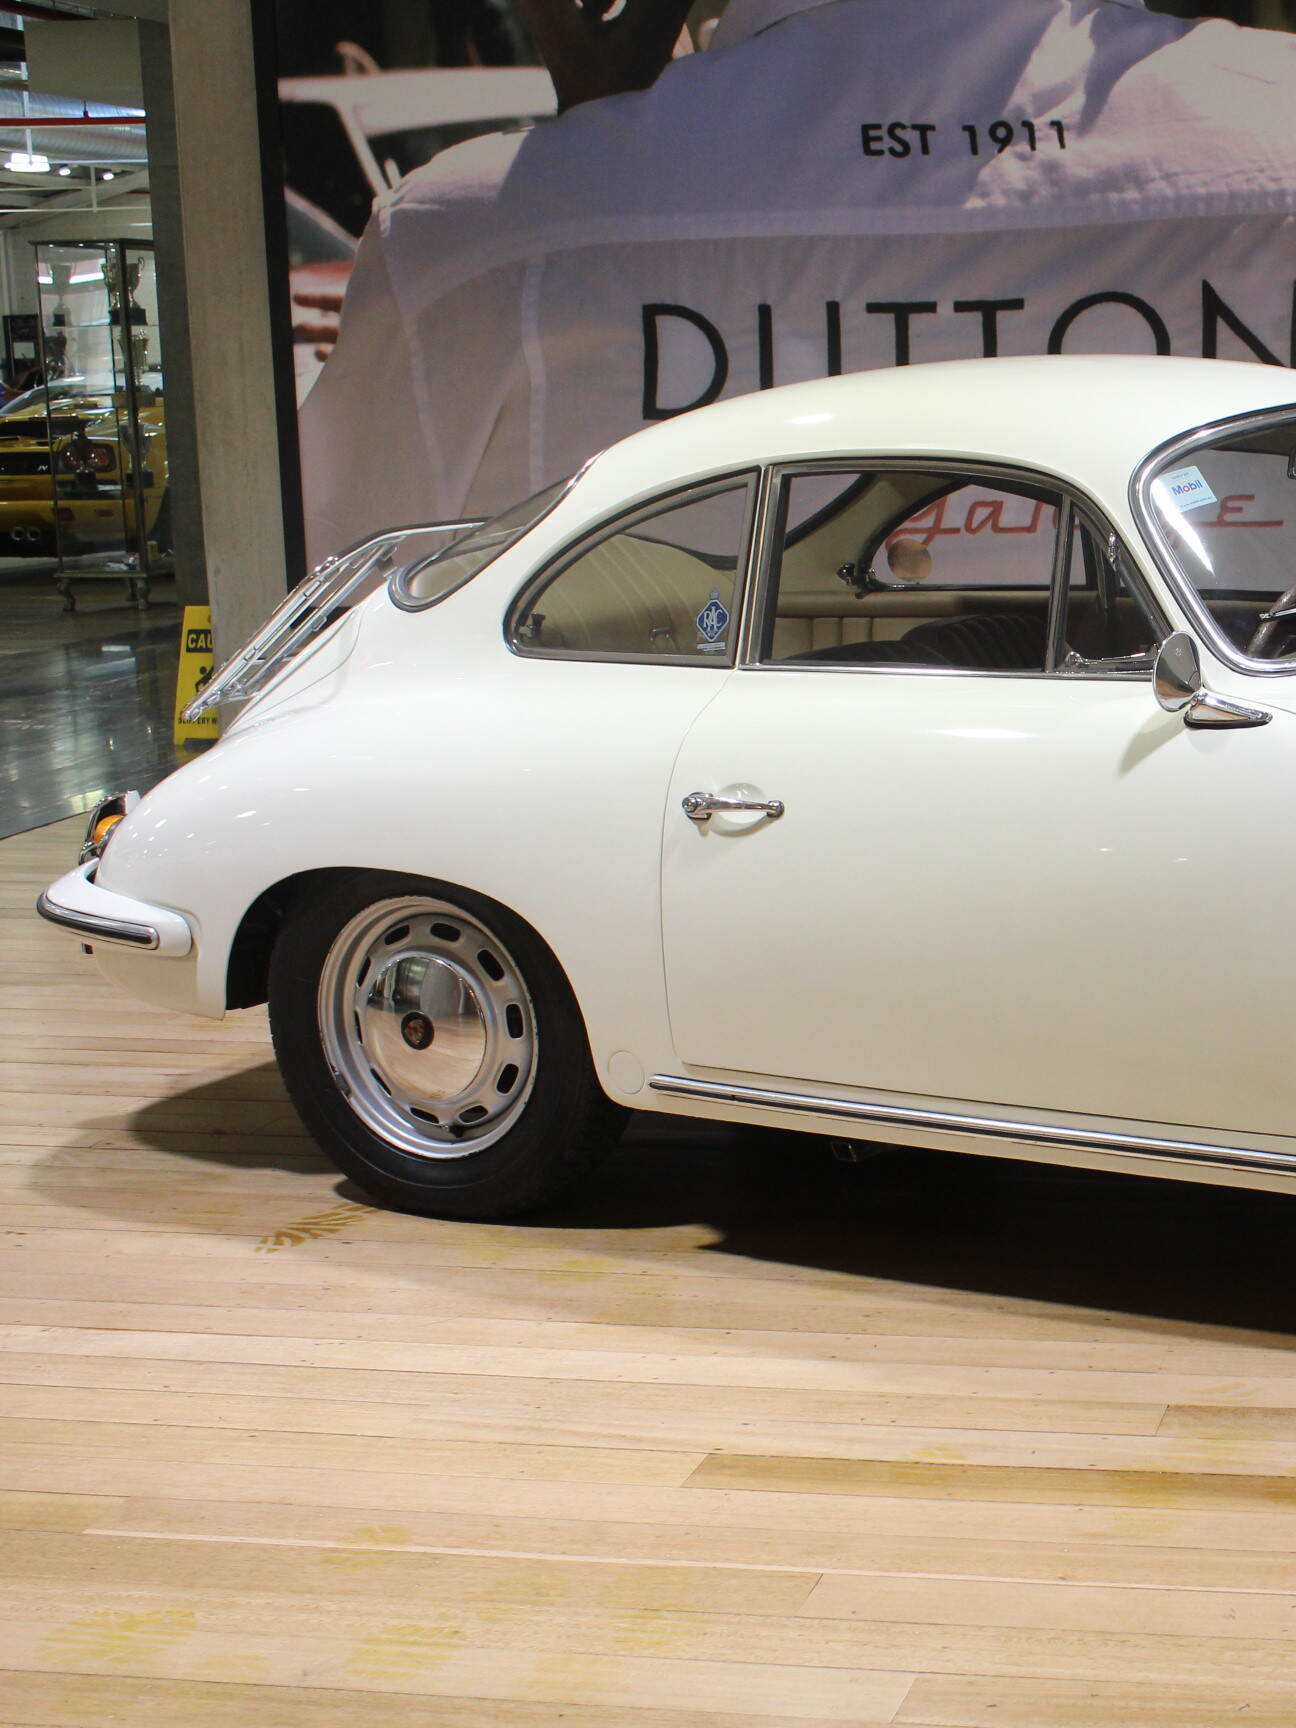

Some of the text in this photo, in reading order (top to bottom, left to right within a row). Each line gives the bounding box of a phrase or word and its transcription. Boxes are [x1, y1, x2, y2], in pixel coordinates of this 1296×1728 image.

[861, 120, 1066, 158] EST 1911
[1172, 480, 1203, 495] Mobil
[703, 606, 723, 631] RAC
